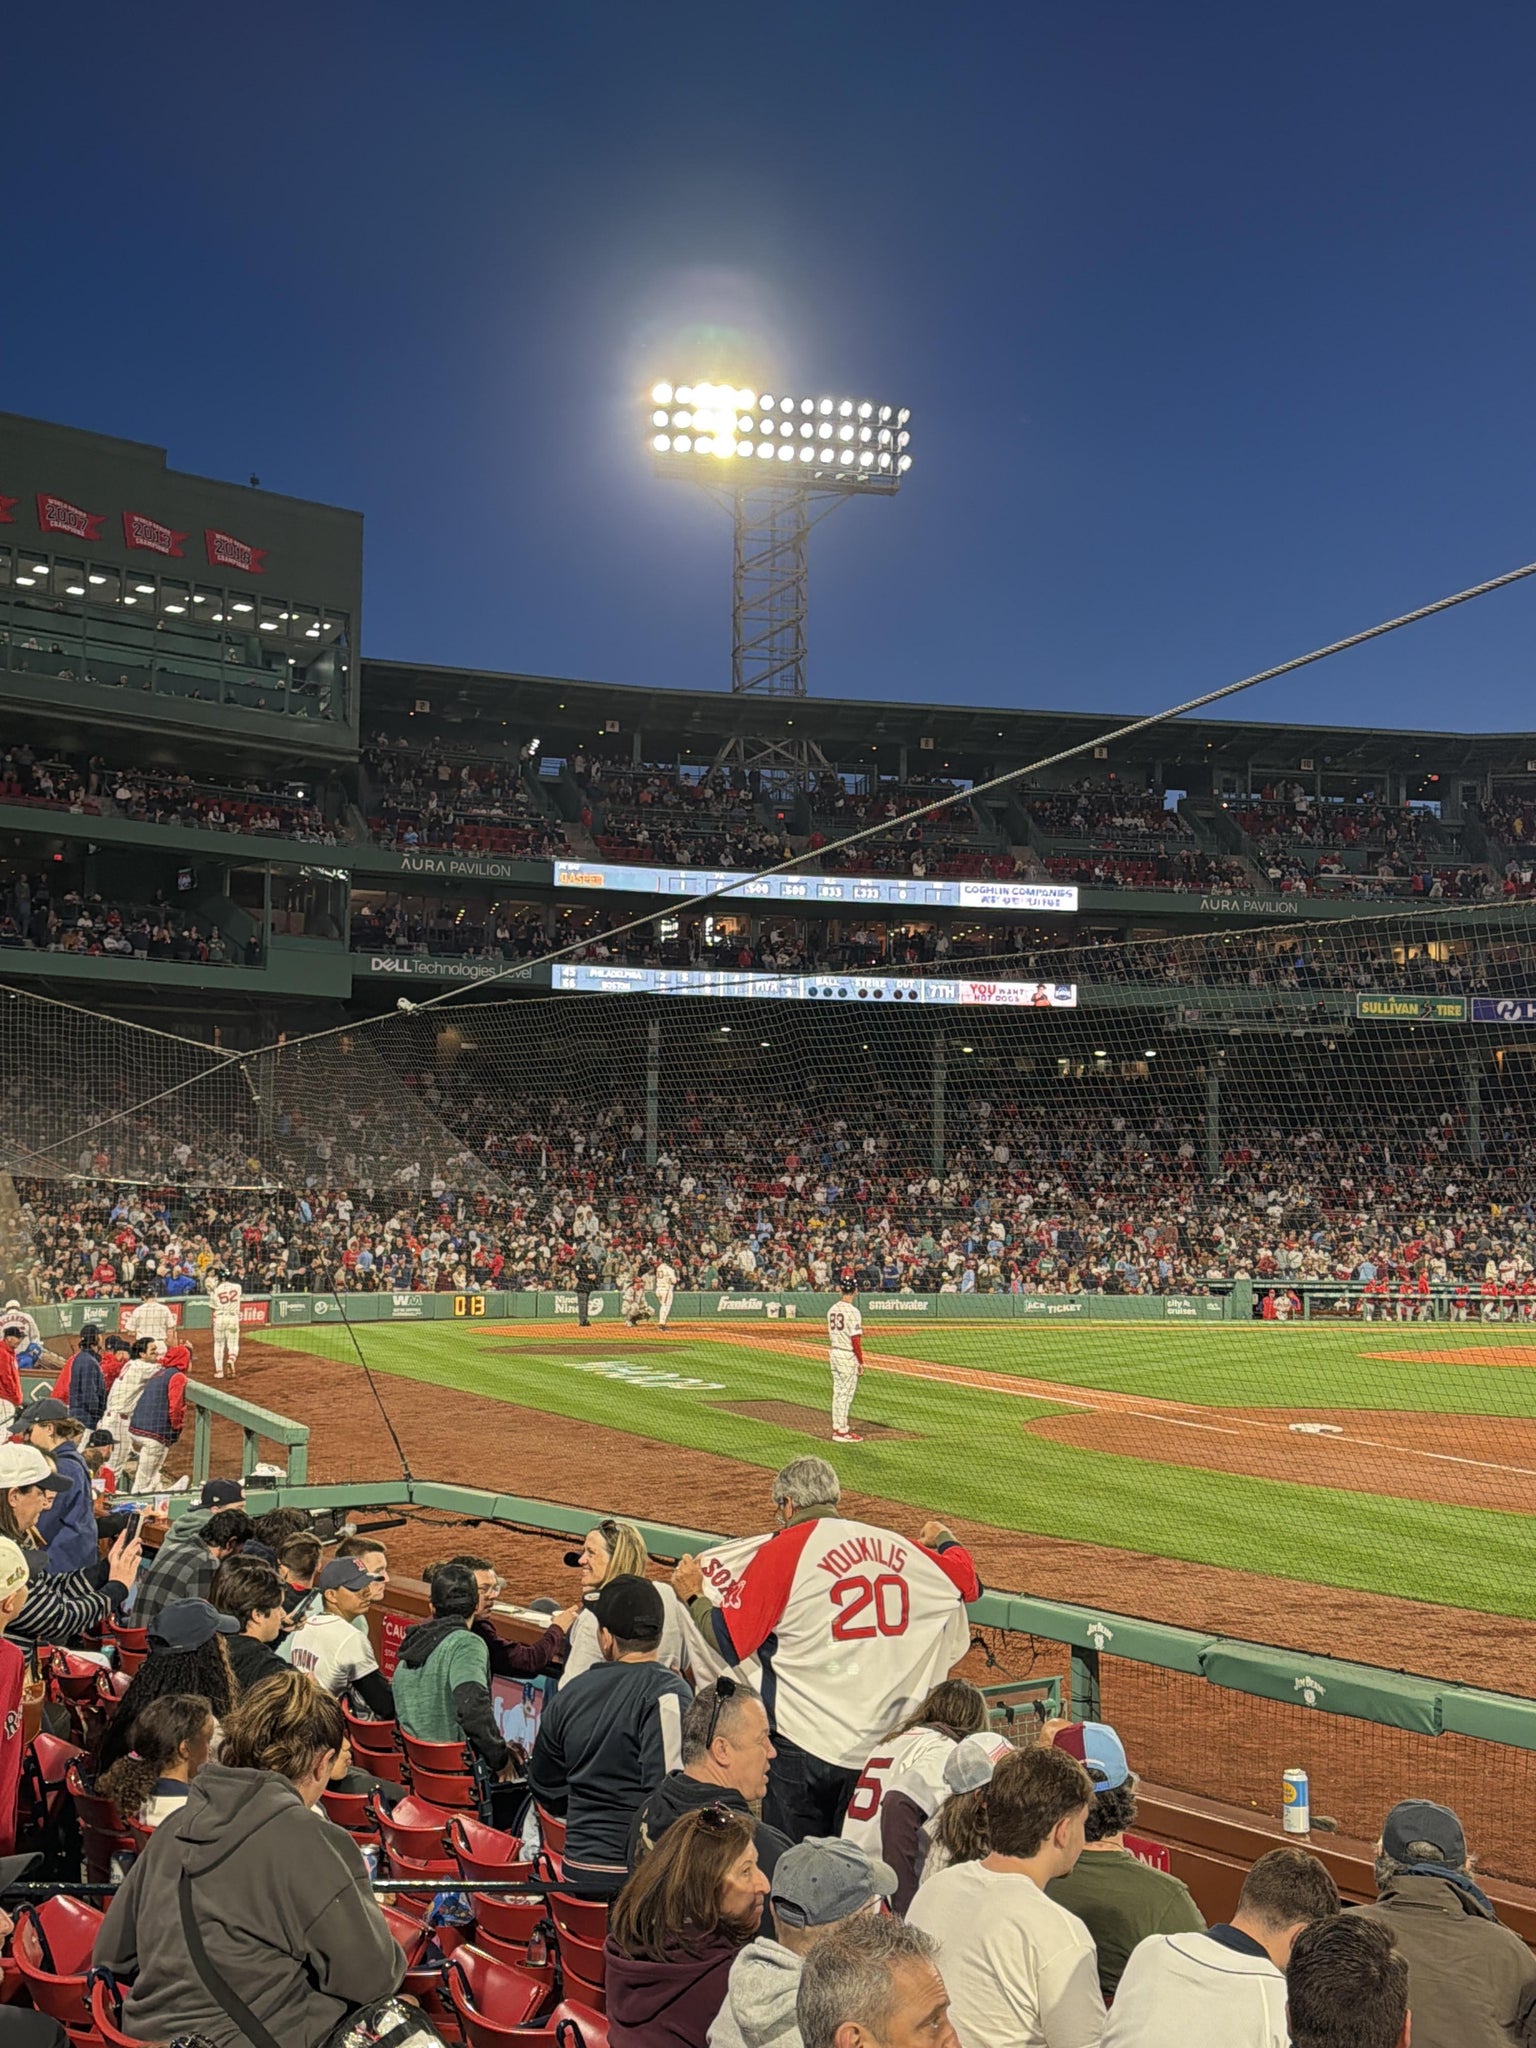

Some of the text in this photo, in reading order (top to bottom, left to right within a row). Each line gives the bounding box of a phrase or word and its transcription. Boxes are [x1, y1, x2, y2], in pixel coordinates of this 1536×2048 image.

[48, 498, 67, 509] WORLD
[45, 504, 88, 531] 2007
[133, 516, 153, 526] WORLD
[50, 520, 85, 537] CHAMPIONS
[132, 522, 172, 549] 2013
[136, 538, 169, 553] CHAMPIONS
[215, 533, 235, 544] WORLD
[214, 540, 252, 565] 2018
[217, 554, 249, 570] CHAMPIONS
[449, 861, 511, 877] PAVILION
[964, 885, 1073, 898] COGHLIN COMPANIES
[1243, 900, 1298, 914] PAVILION
[371, 957, 412, 973] DELL
[411, 959, 496, 980] Technologies
[589, 968, 642, 980] PHILADELPHIA
[601, 980, 631, 990] BOSTON
[855, 978, 886, 988] STRIKE
[896, 979, 915, 988] OUT
[970, 983, 997, 997] YOU
[929, 985, 955, 998] 7TH
[995, 995, 1020, 1003] DOGS
[1361, 1001, 1462, 1017] SULLIVAN TIRE
[218, 1290, 239, 1305] 52
[392, 1295, 424, 1306] WM
[554, 1295, 579, 1304] Ninet
[868, 1298, 929, 1311] smartwater
[554, 1303, 579, 1314] Nin
[1027, 1300, 1082, 1314] ACE TICKET
[1167, 1307, 1197, 1316] cruises
[817, 1536, 908, 1579] YOUKILIS
[829, 1574, 910, 1642] 20
[385, 1622, 408, 1640] CAU
[1304, 1675, 1327, 1697] BEAM
